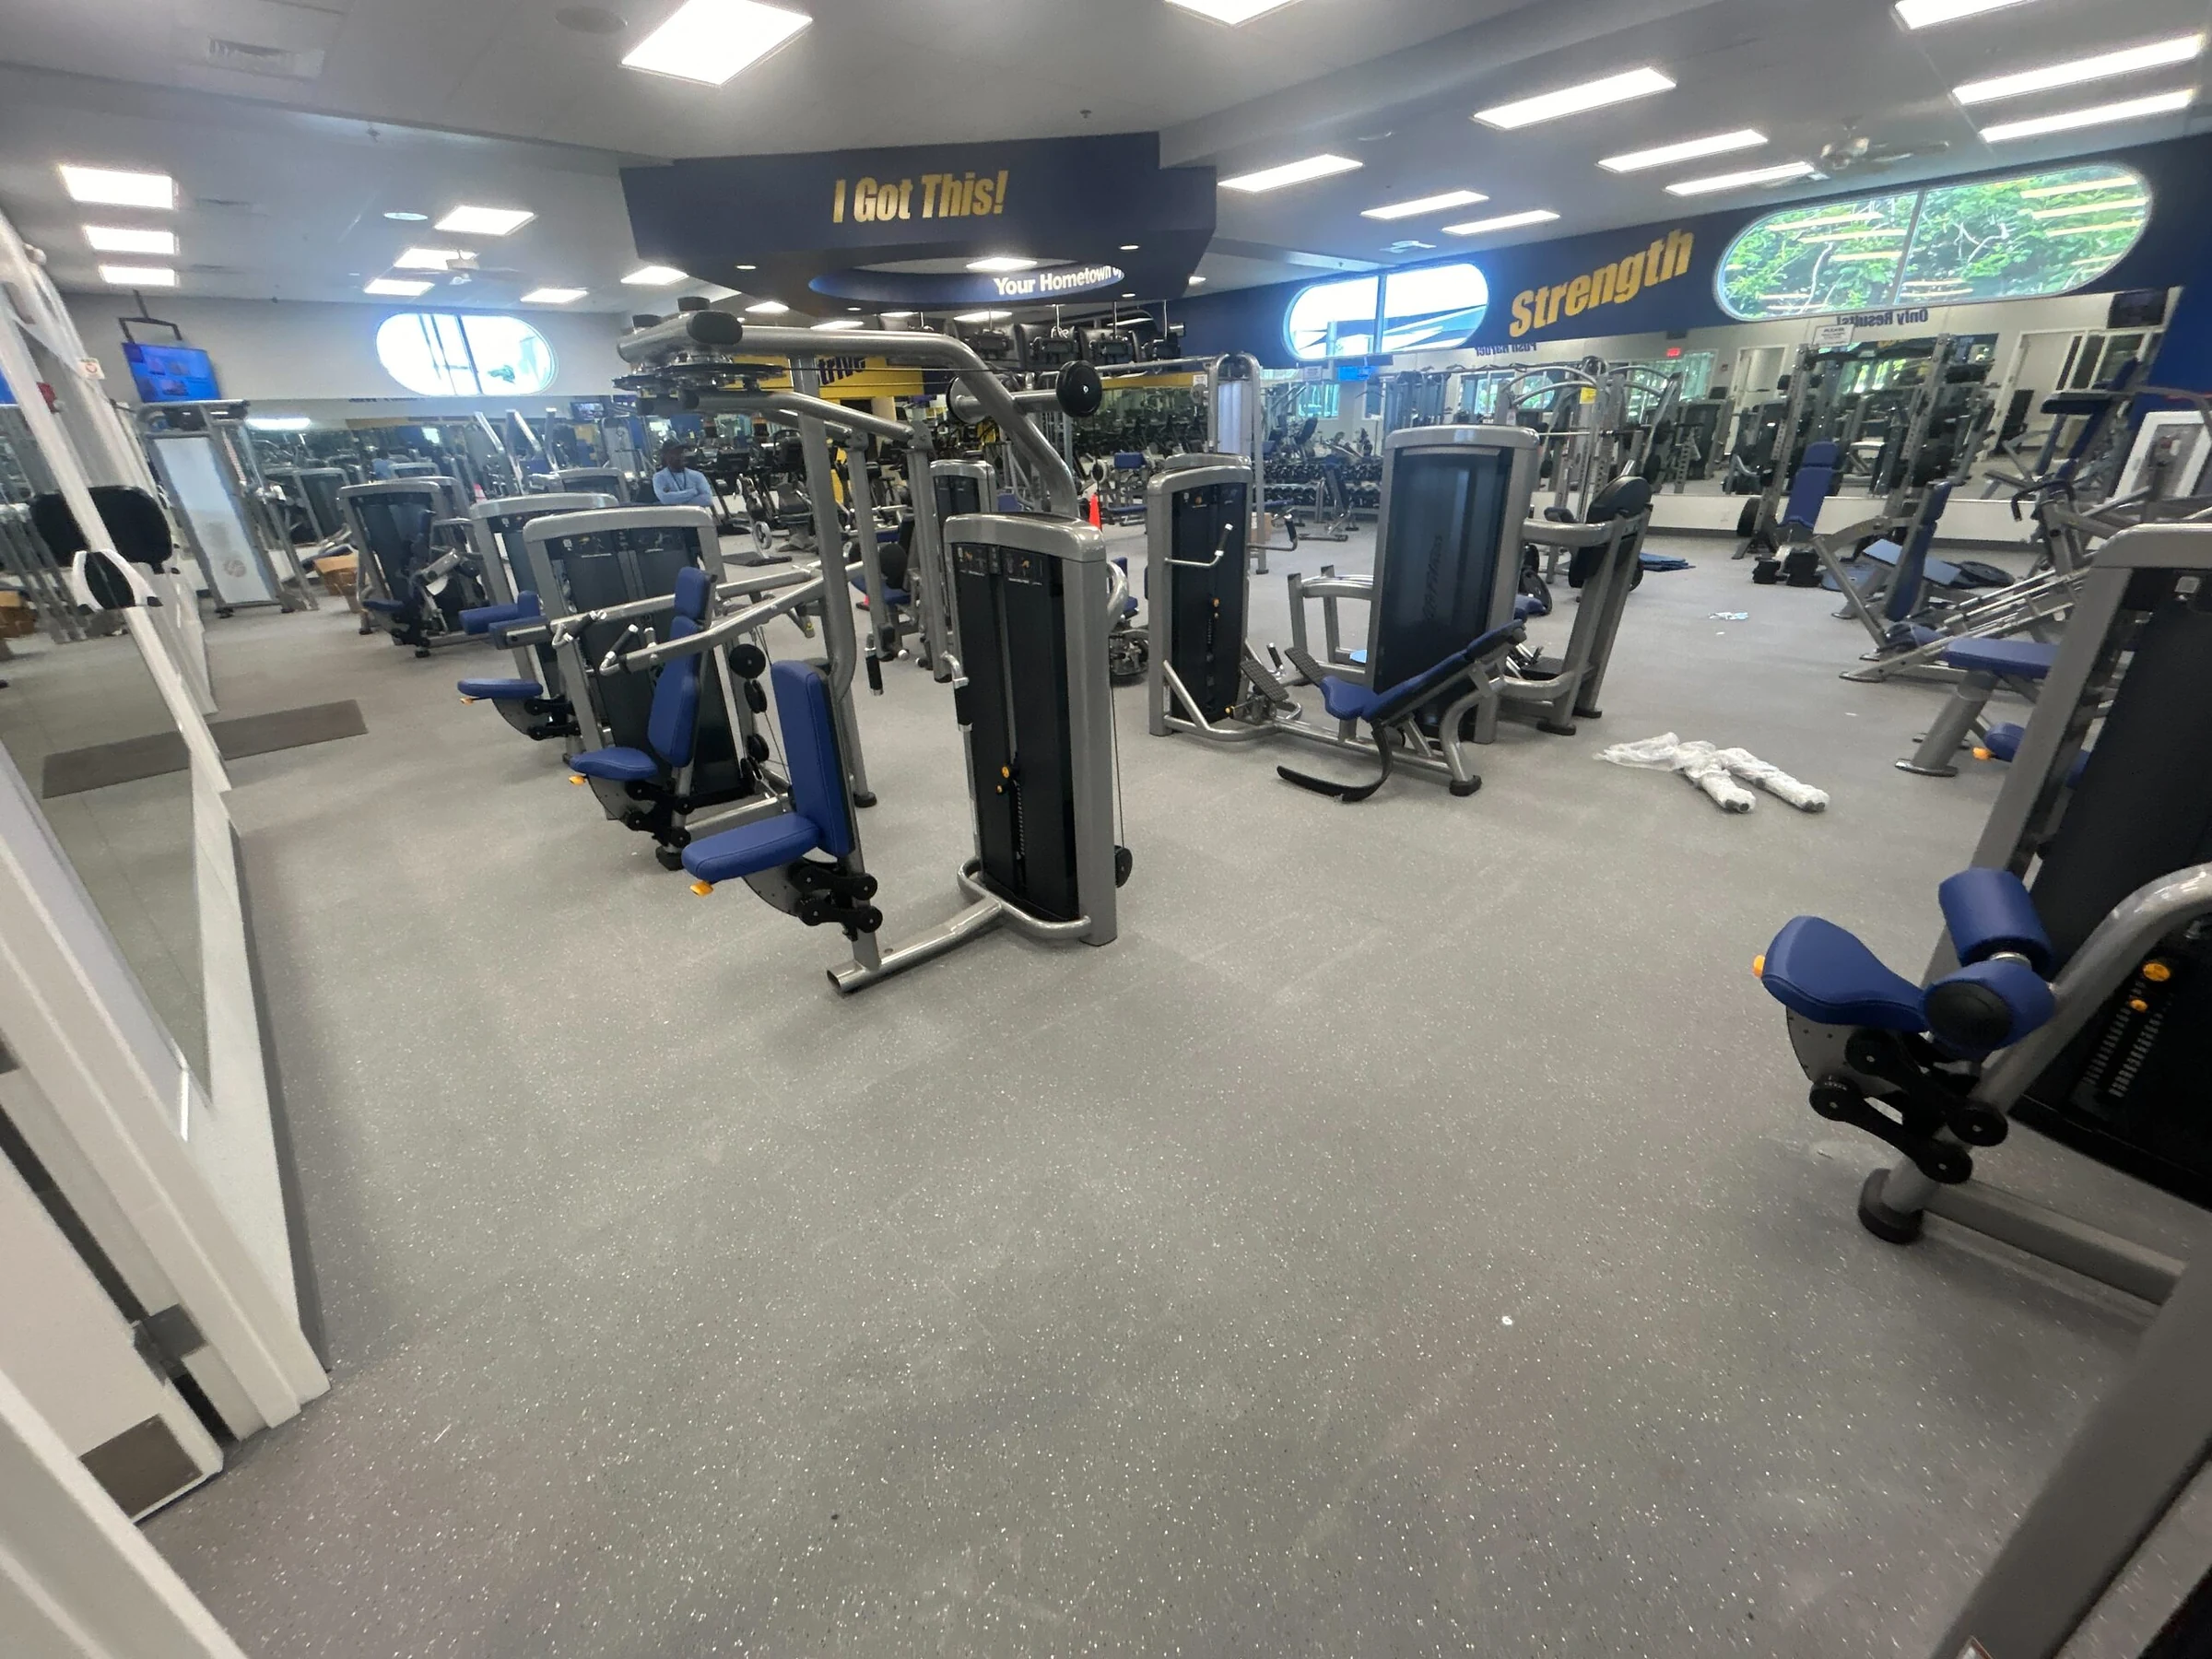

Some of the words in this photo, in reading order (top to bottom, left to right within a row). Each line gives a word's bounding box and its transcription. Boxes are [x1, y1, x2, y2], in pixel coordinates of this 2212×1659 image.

[833, 179, 846, 223] I
[853, 177, 913, 223] Got
[921, 170, 1009, 218] This!
[994, 276, 1035, 296] Your
[1040, 265, 1112, 292] Hometown
[1509, 229, 1695, 337] Strength
